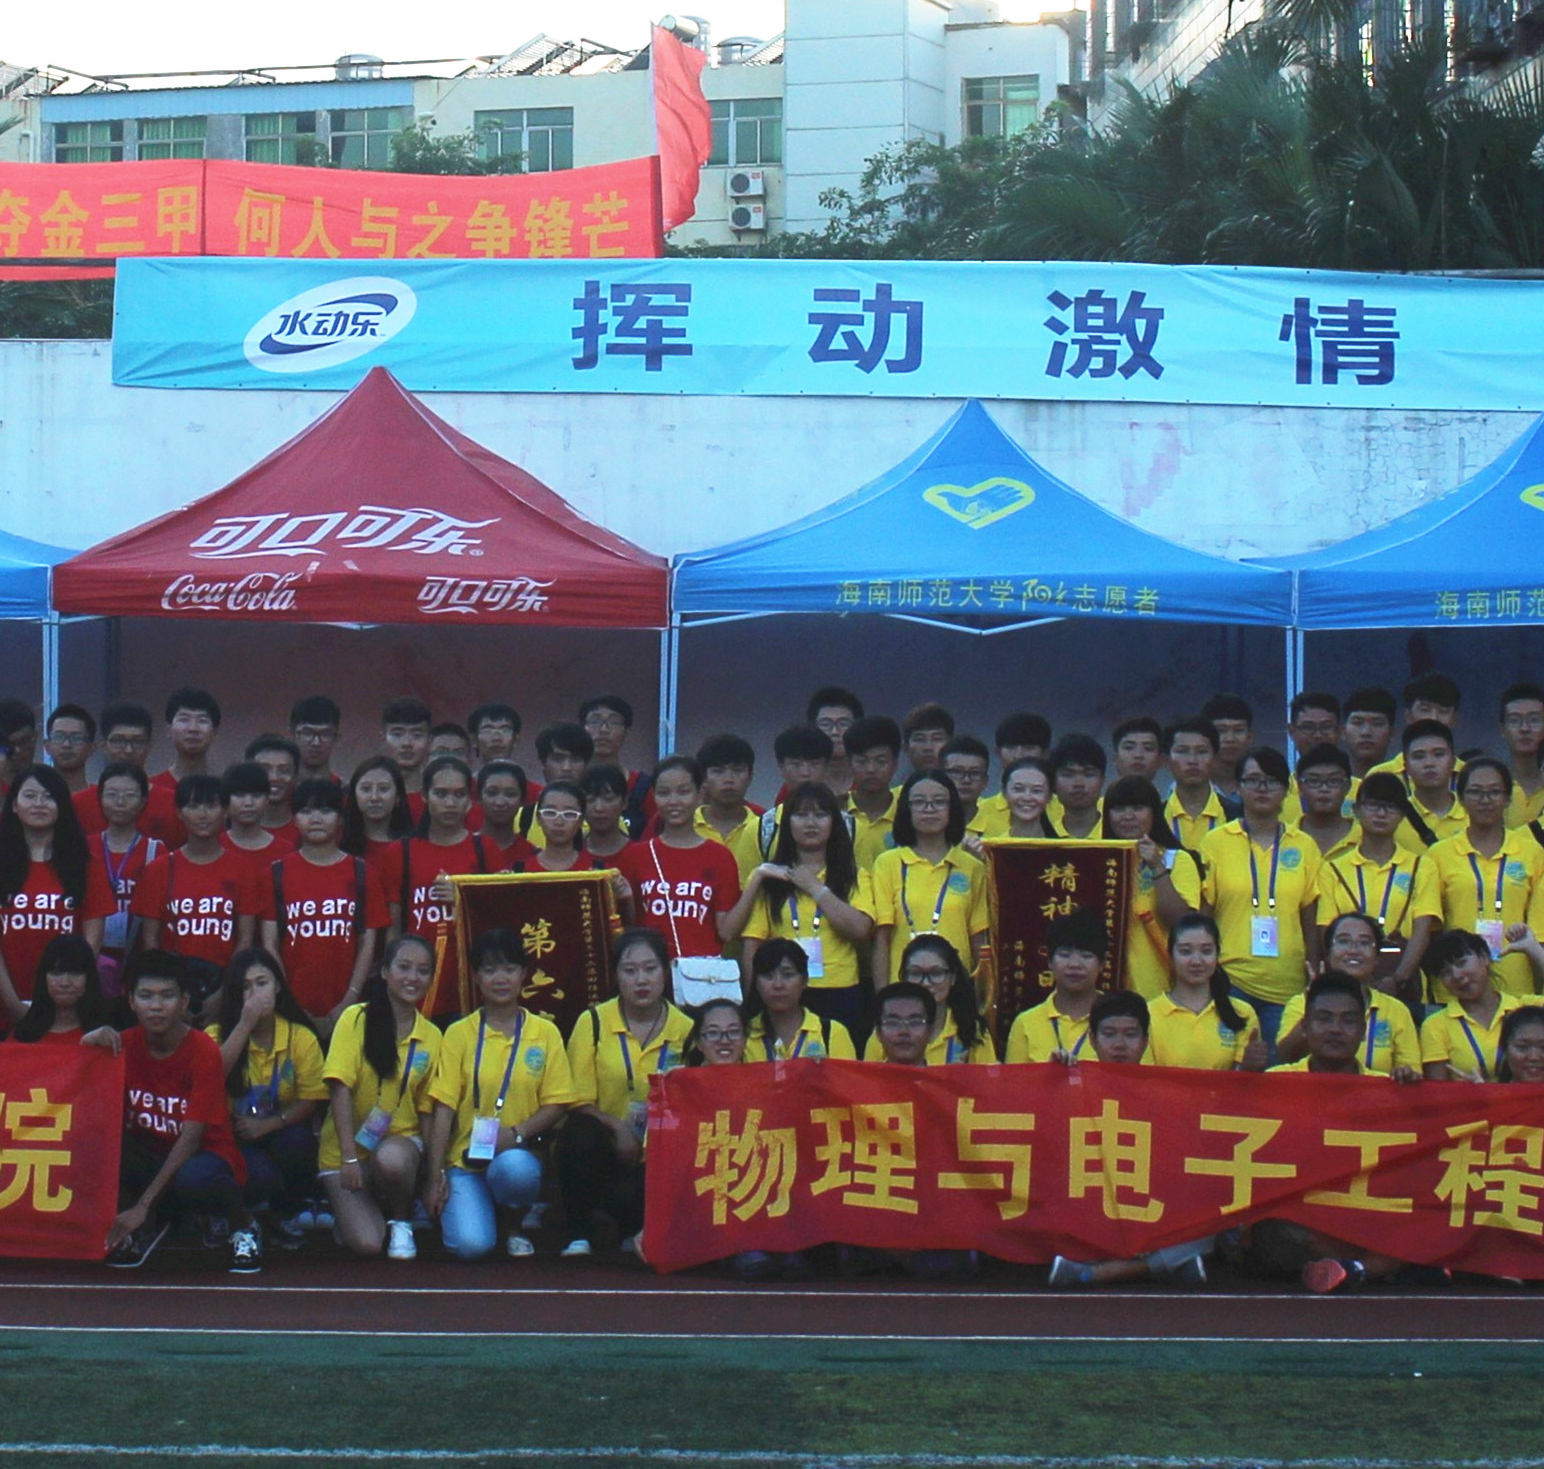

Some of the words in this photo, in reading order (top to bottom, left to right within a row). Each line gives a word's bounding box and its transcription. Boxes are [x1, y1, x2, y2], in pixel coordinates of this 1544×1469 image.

[233, 183, 631, 259] 何人与之争锋芒
[274, 310, 383, 337] 水动乐
[572, 280, 1401, 387] 挥动激情
[189, 505, 501, 557] 可口可乐
[417, 576, 556, 614] 可口可乐
[34, 893, 75, 911] are
[641, 880, 670, 896] we
[675, 881, 713, 901] are
[198, 897, 233, 915] are
[287, 900, 316, 919] we
[322, 898, 355, 916] are
[413, 905, 455, 930] you
[0, 913, 73, 934] young
[167, 917, 233, 941] oung
[157, 1096, 188, 1114] are
[127, 1112, 183, 1135] oun
